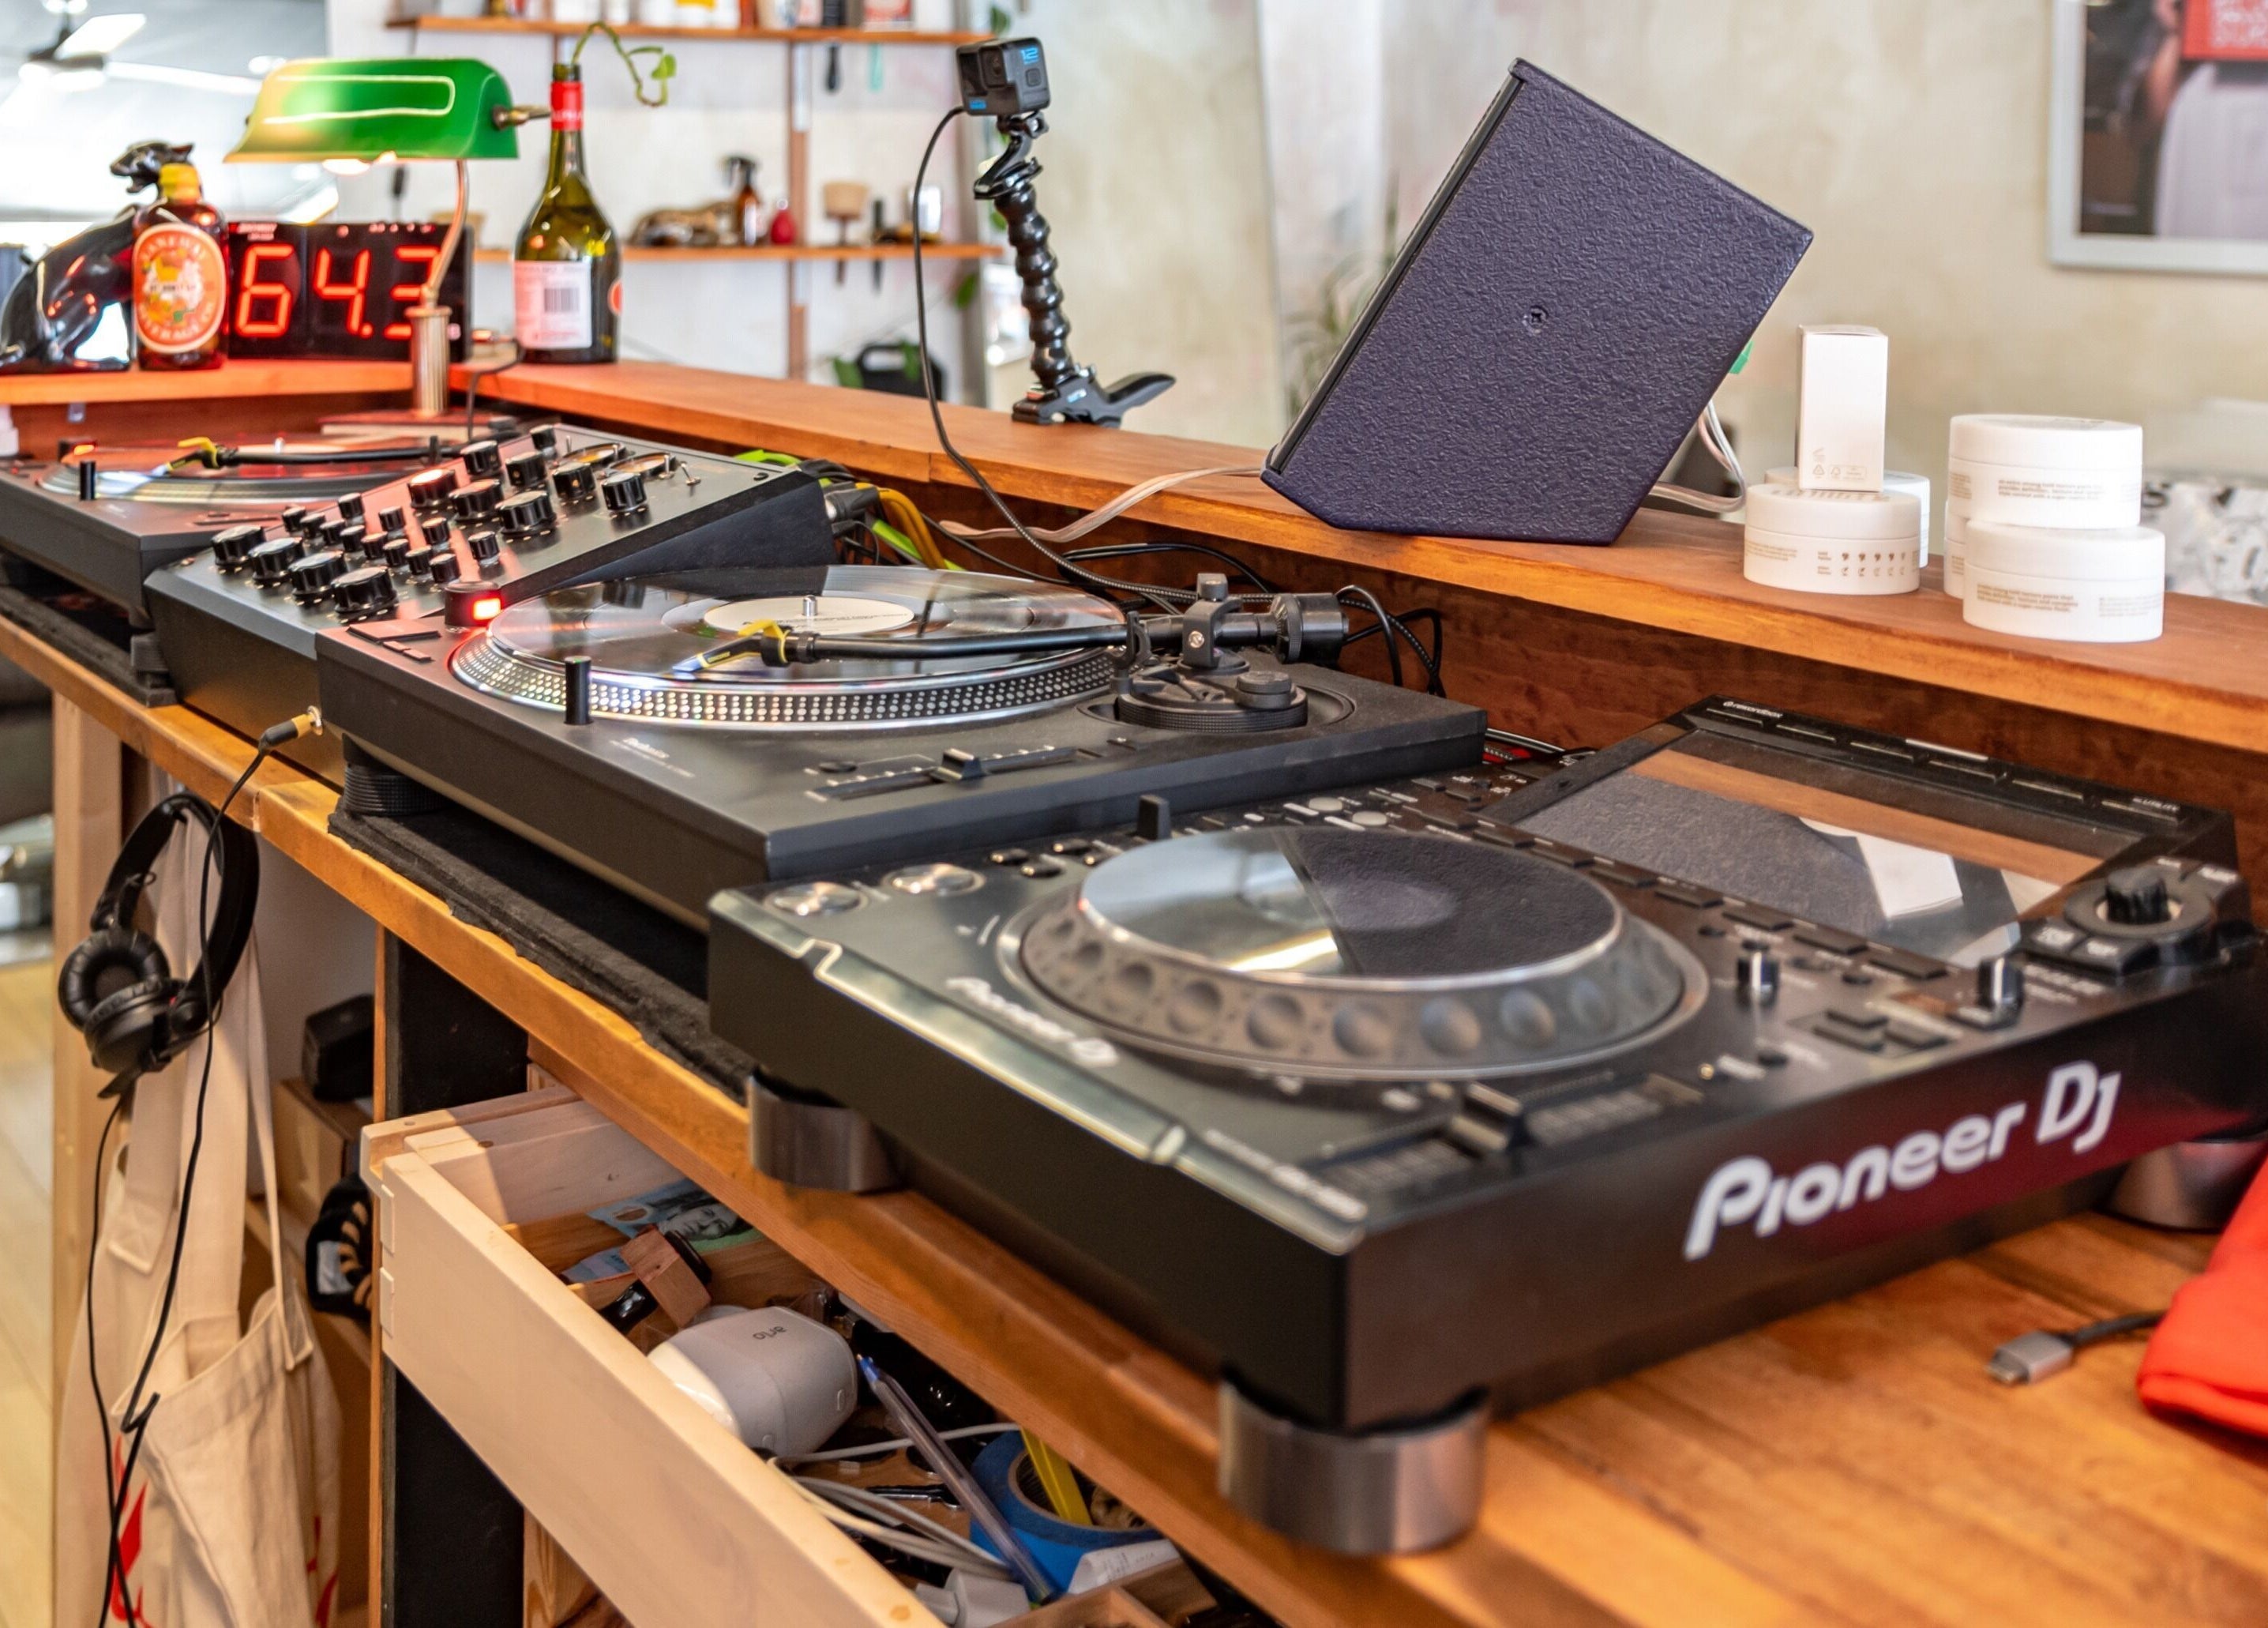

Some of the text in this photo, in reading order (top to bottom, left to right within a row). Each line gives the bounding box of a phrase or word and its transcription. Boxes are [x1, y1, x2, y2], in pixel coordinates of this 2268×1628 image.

[1021, 47, 1039, 62] 12
[1684, 1101, 2027, 1261] Pioneer
[753, 1326, 787, 1340] arlo
